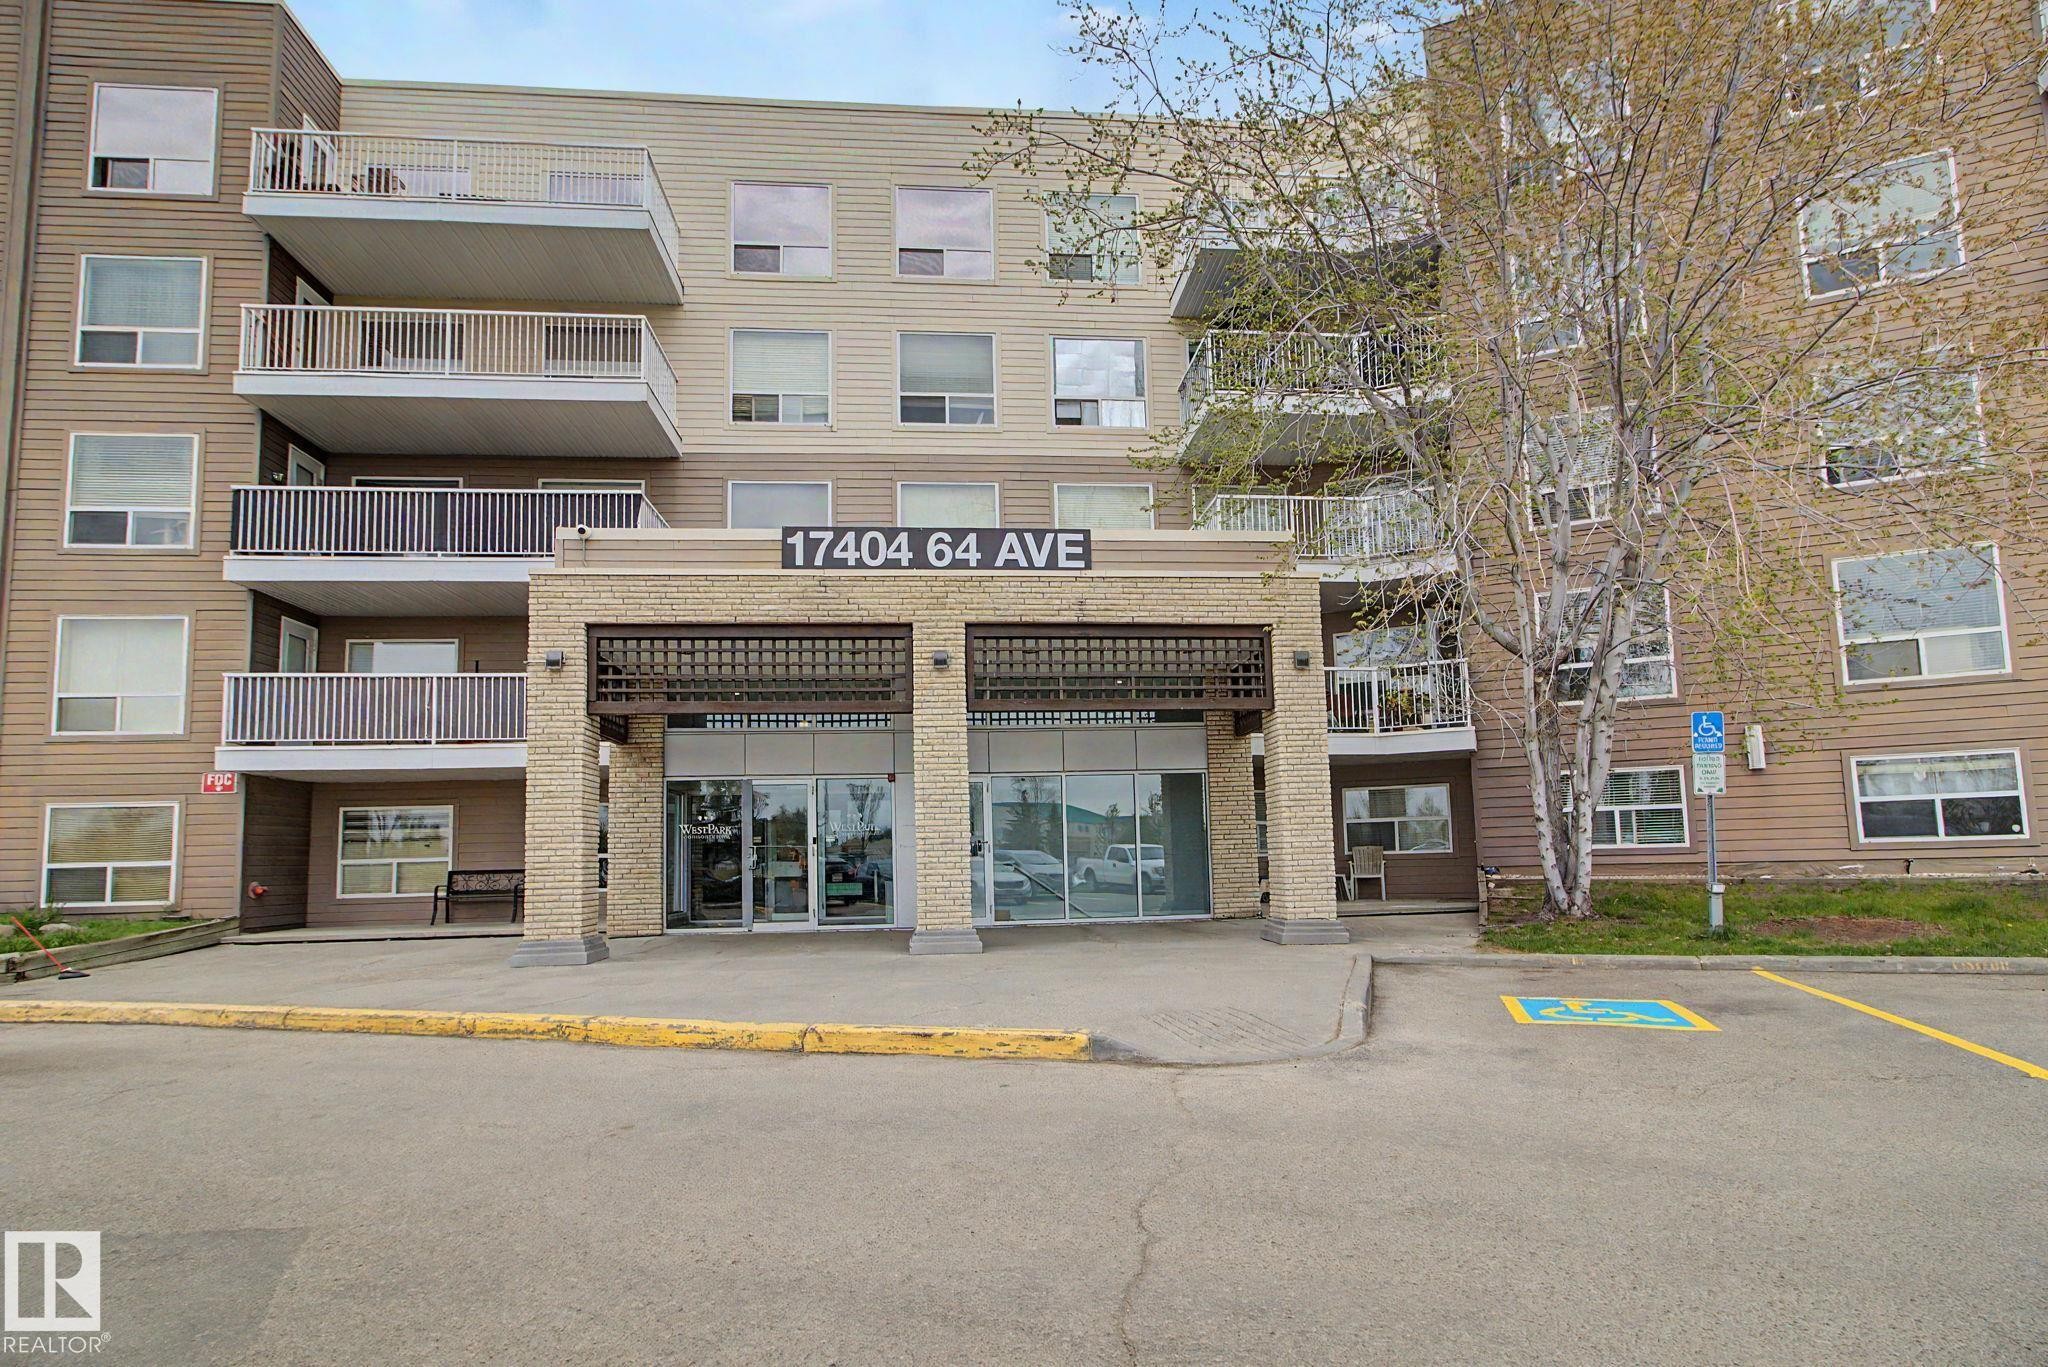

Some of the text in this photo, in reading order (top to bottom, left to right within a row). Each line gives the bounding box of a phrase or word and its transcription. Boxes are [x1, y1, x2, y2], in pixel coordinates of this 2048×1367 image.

[786, 531, 1086, 568] 17404 64 AVE
[207, 773, 232, 786] FDC
